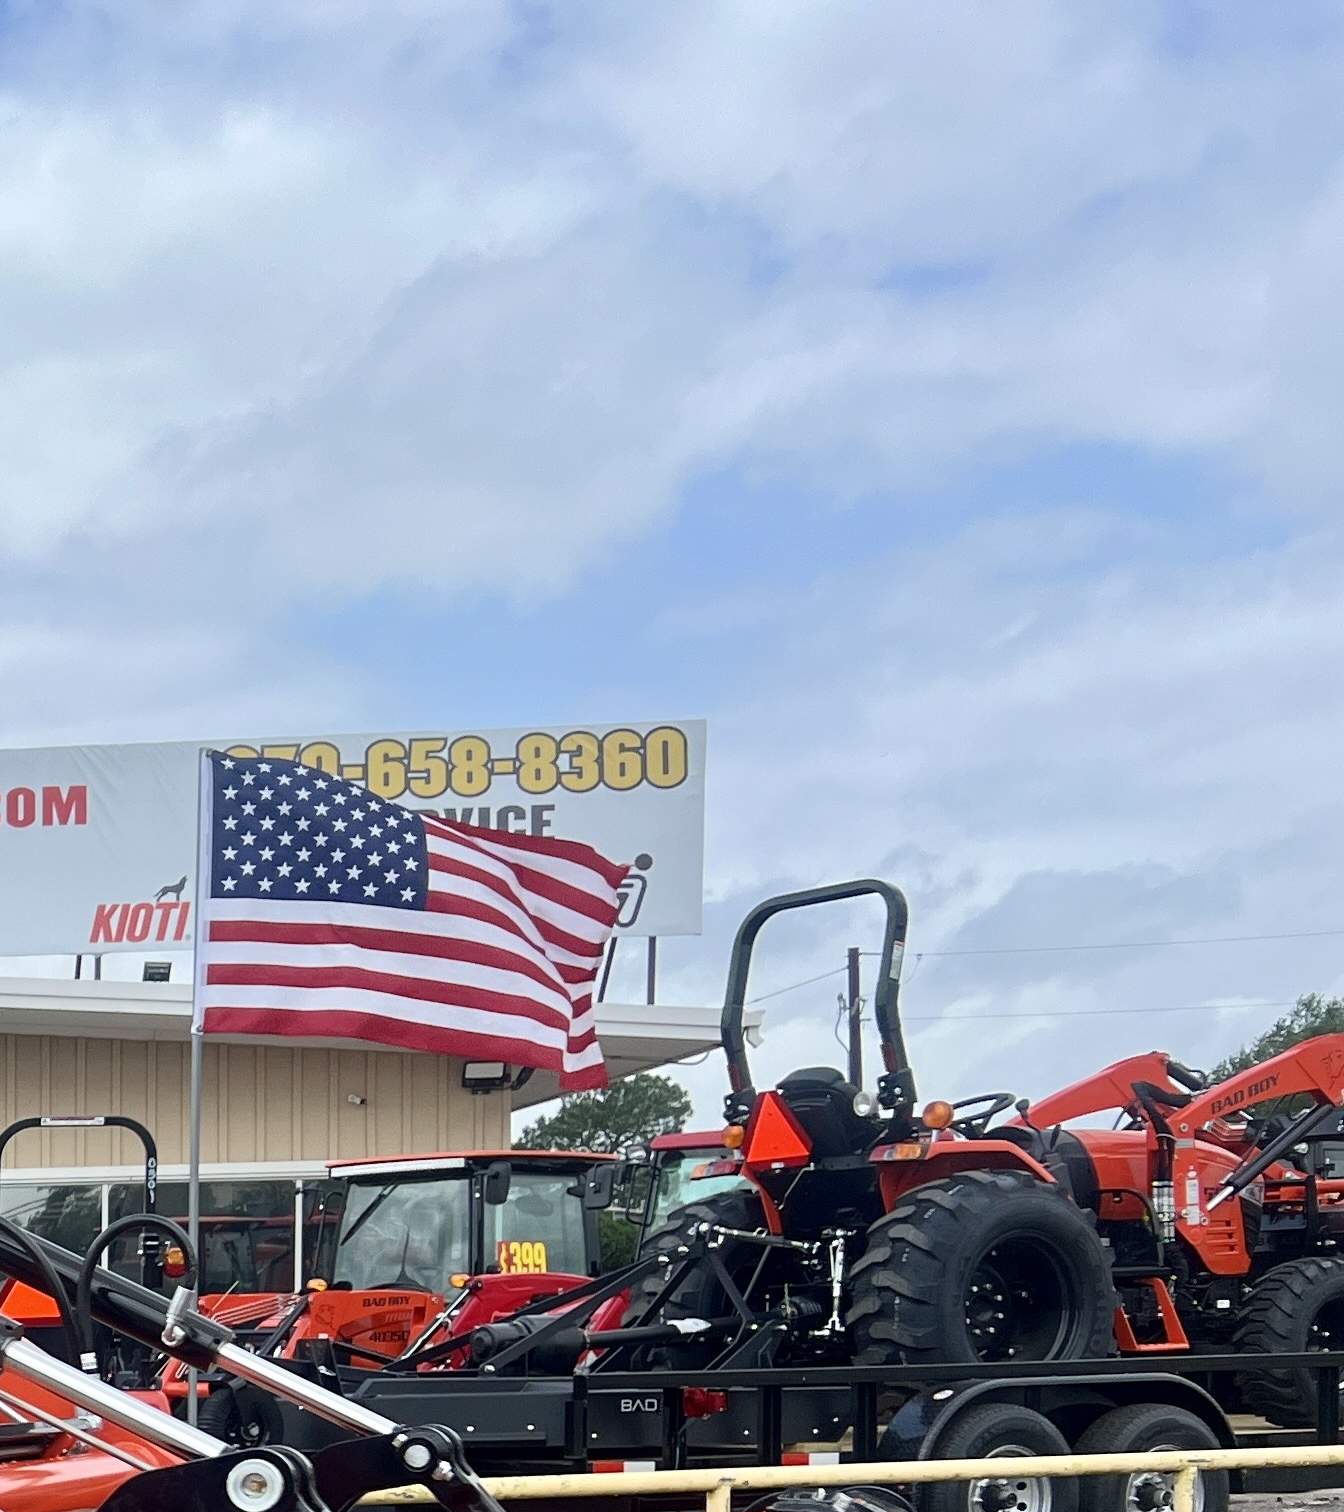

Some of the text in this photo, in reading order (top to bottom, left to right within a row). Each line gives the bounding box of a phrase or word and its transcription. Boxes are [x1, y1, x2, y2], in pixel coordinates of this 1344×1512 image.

[89, 901, 190, 943] KIOTI
[1212, 1072, 1281, 1115] BAD BOY
[620, 1398, 658, 1412] BAD
